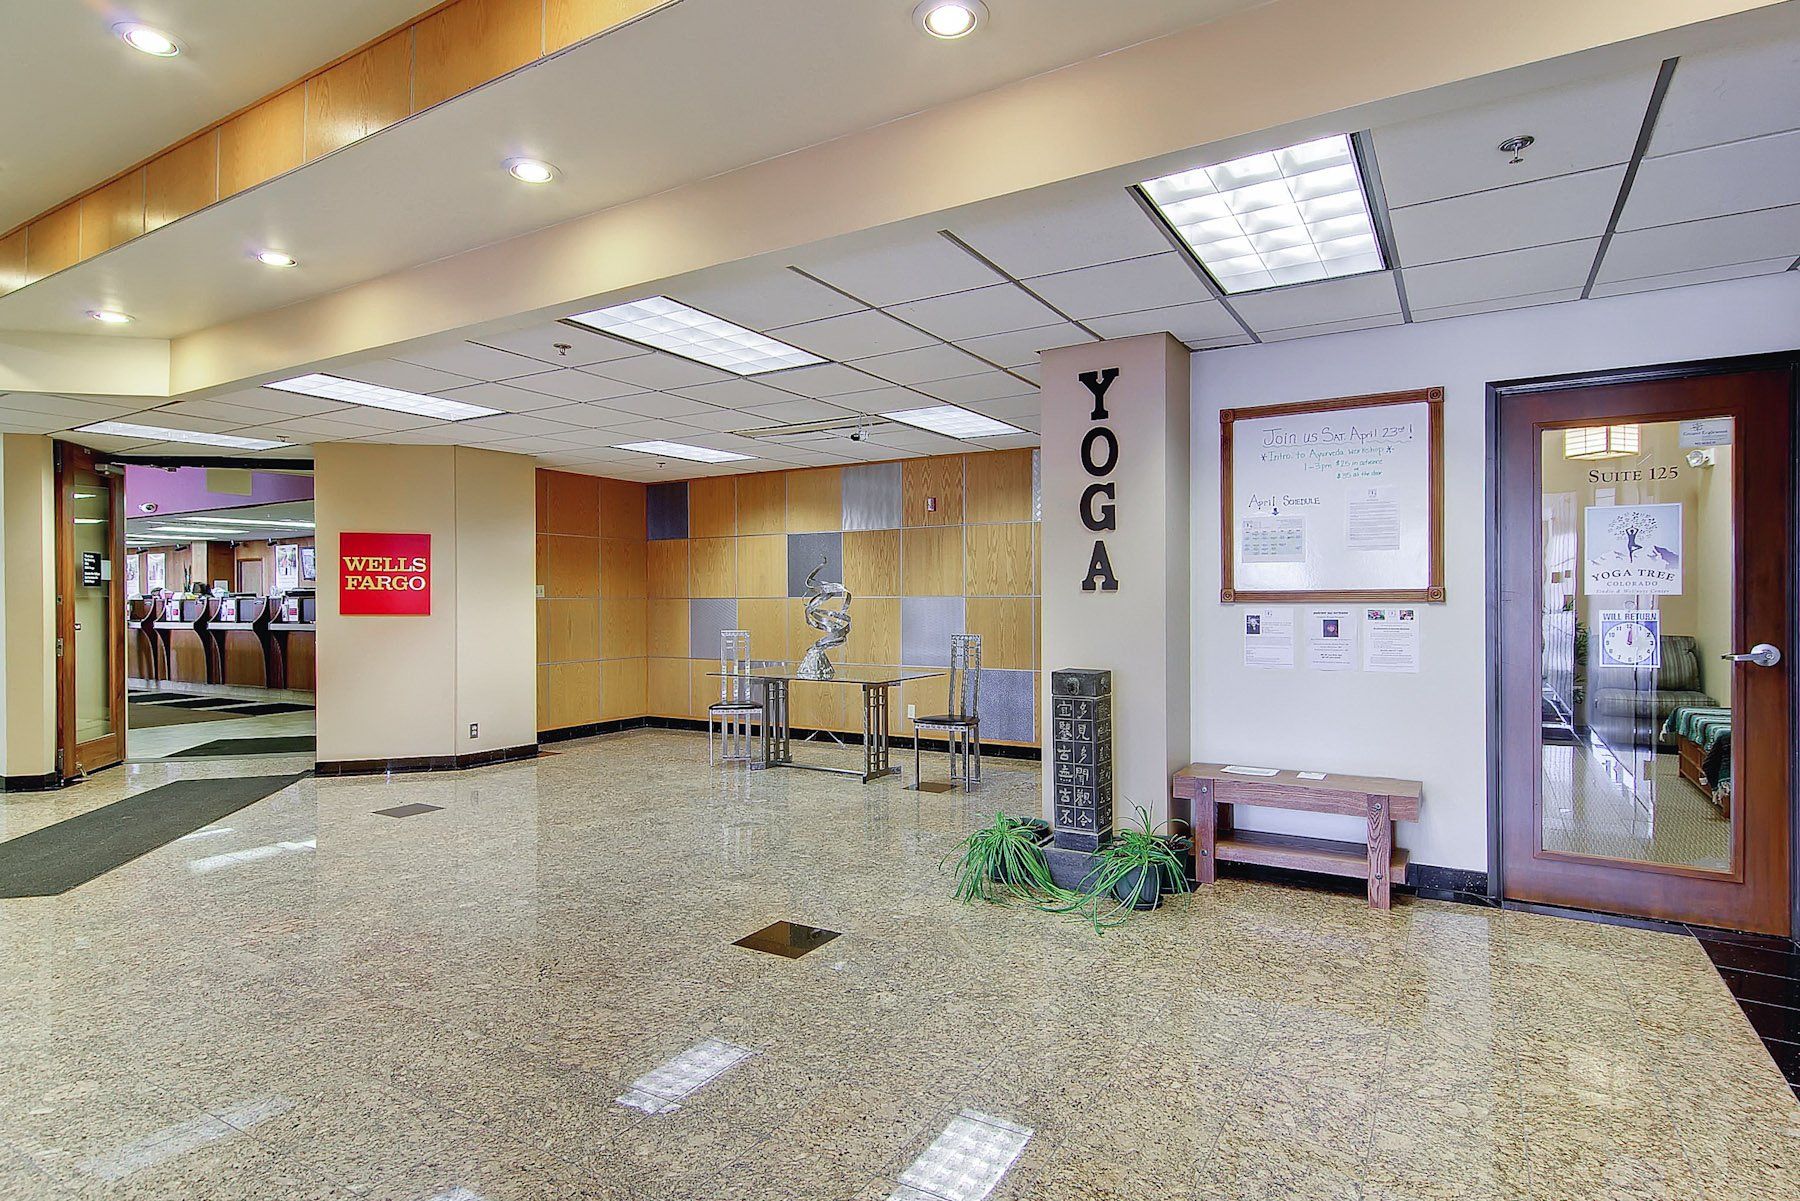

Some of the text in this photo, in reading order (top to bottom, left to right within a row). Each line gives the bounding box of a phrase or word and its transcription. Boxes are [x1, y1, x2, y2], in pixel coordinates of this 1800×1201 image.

[1263, 428, 1296, 446] Join
[1303, 432, 1318, 444] us
[1350, 426, 1377, 445] April
[1297, 450, 1306, 459] to
[1309, 449, 1344, 461] Ayurveda
[1078, 367, 1119, 591] YOGA
[1588, 466, 1679, 483] SUITE 125
[1248, 494, 1275, 510] April
[343, 556, 427, 573] WELLS
[345, 575, 427, 592] FARGO
[1592, 568, 1676, 582] YOGA TREE
[1603, 613, 1657, 621] WILL RETURN
